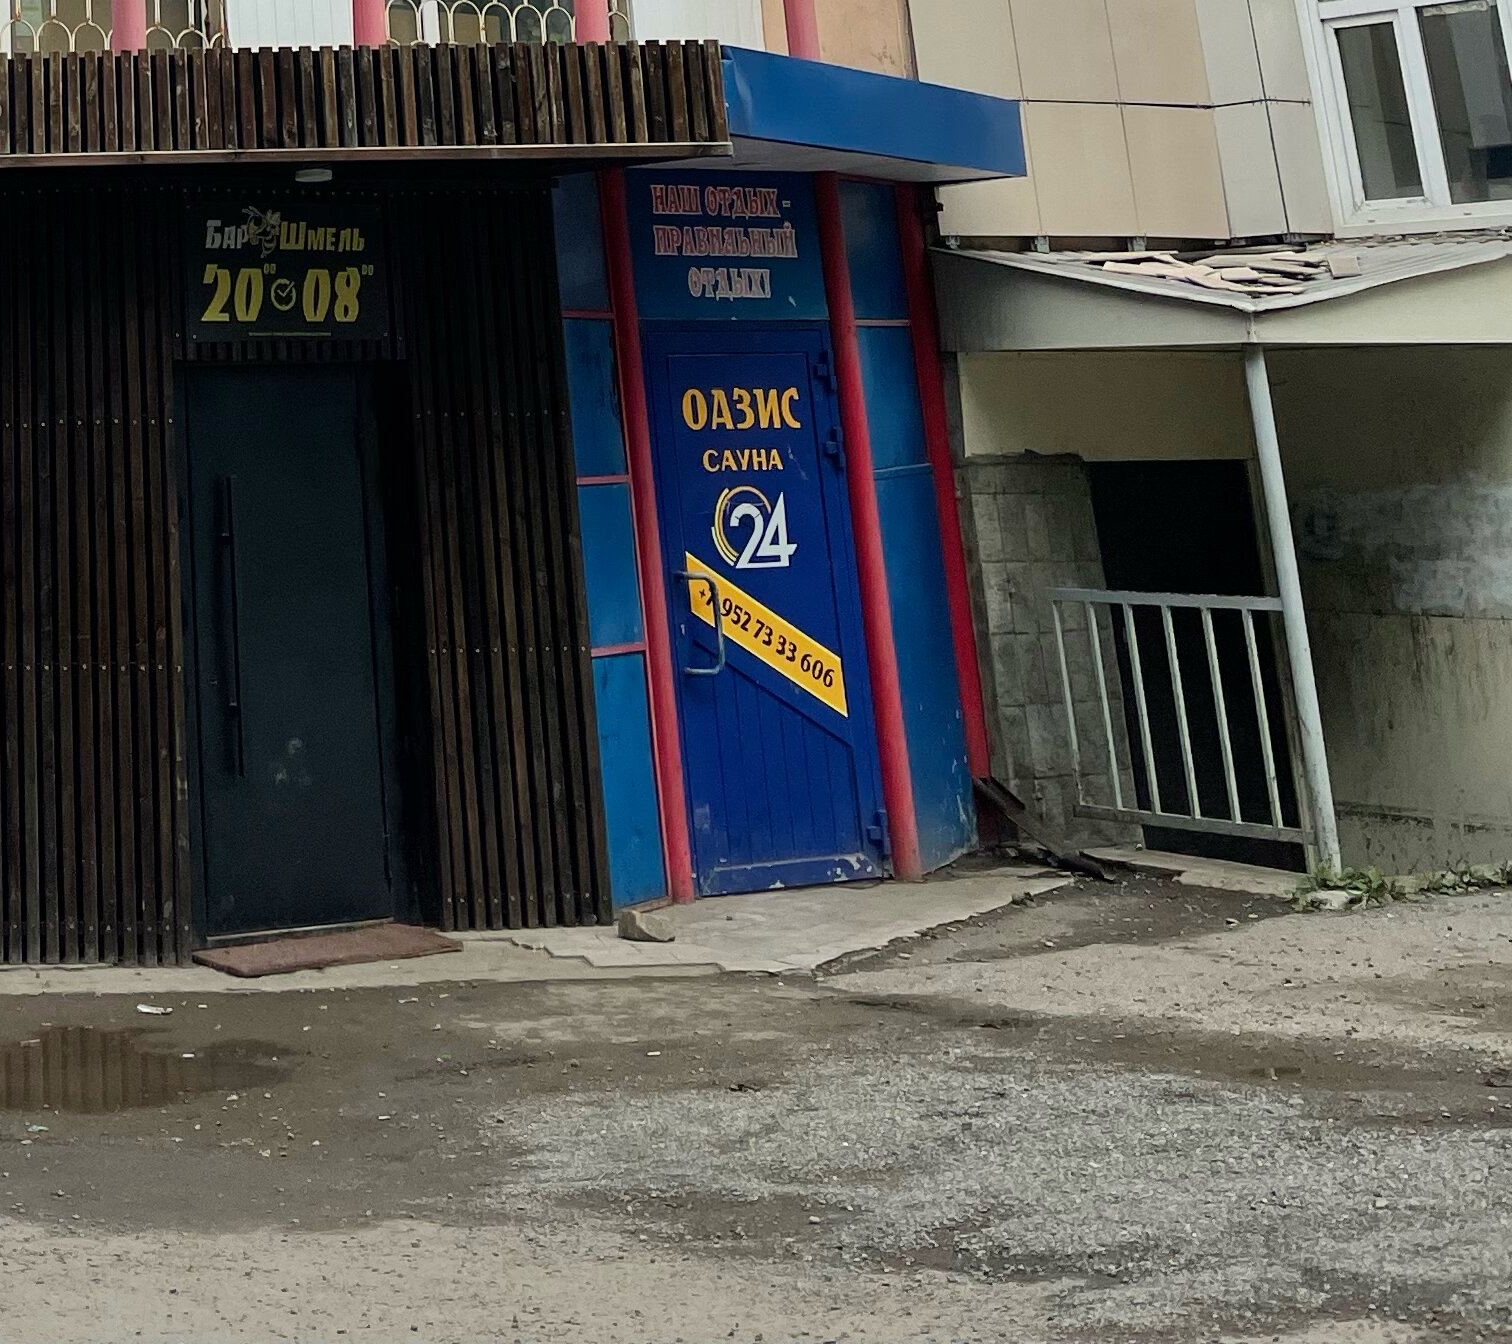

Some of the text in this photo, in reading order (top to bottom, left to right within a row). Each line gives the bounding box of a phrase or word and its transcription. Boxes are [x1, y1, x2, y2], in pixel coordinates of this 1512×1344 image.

[650, 185, 702, 214] НАШ
[705, 186, 781, 220] ОТДЫХ
[653, 221, 798, 258] ПРАВИЛЬНЫЙ
[688, 267, 771, 302] ОТДЫХ!
[682, 387, 801, 430] ОАЗИС
[702, 448, 784, 473] САУНА
[729, 491, 797, 569] 24
[721, 597, 752, 633] 952
[754, 618, 774, 648] 73
[775, 634, 797, 663] 33
[800, 653, 835, 689] 606
